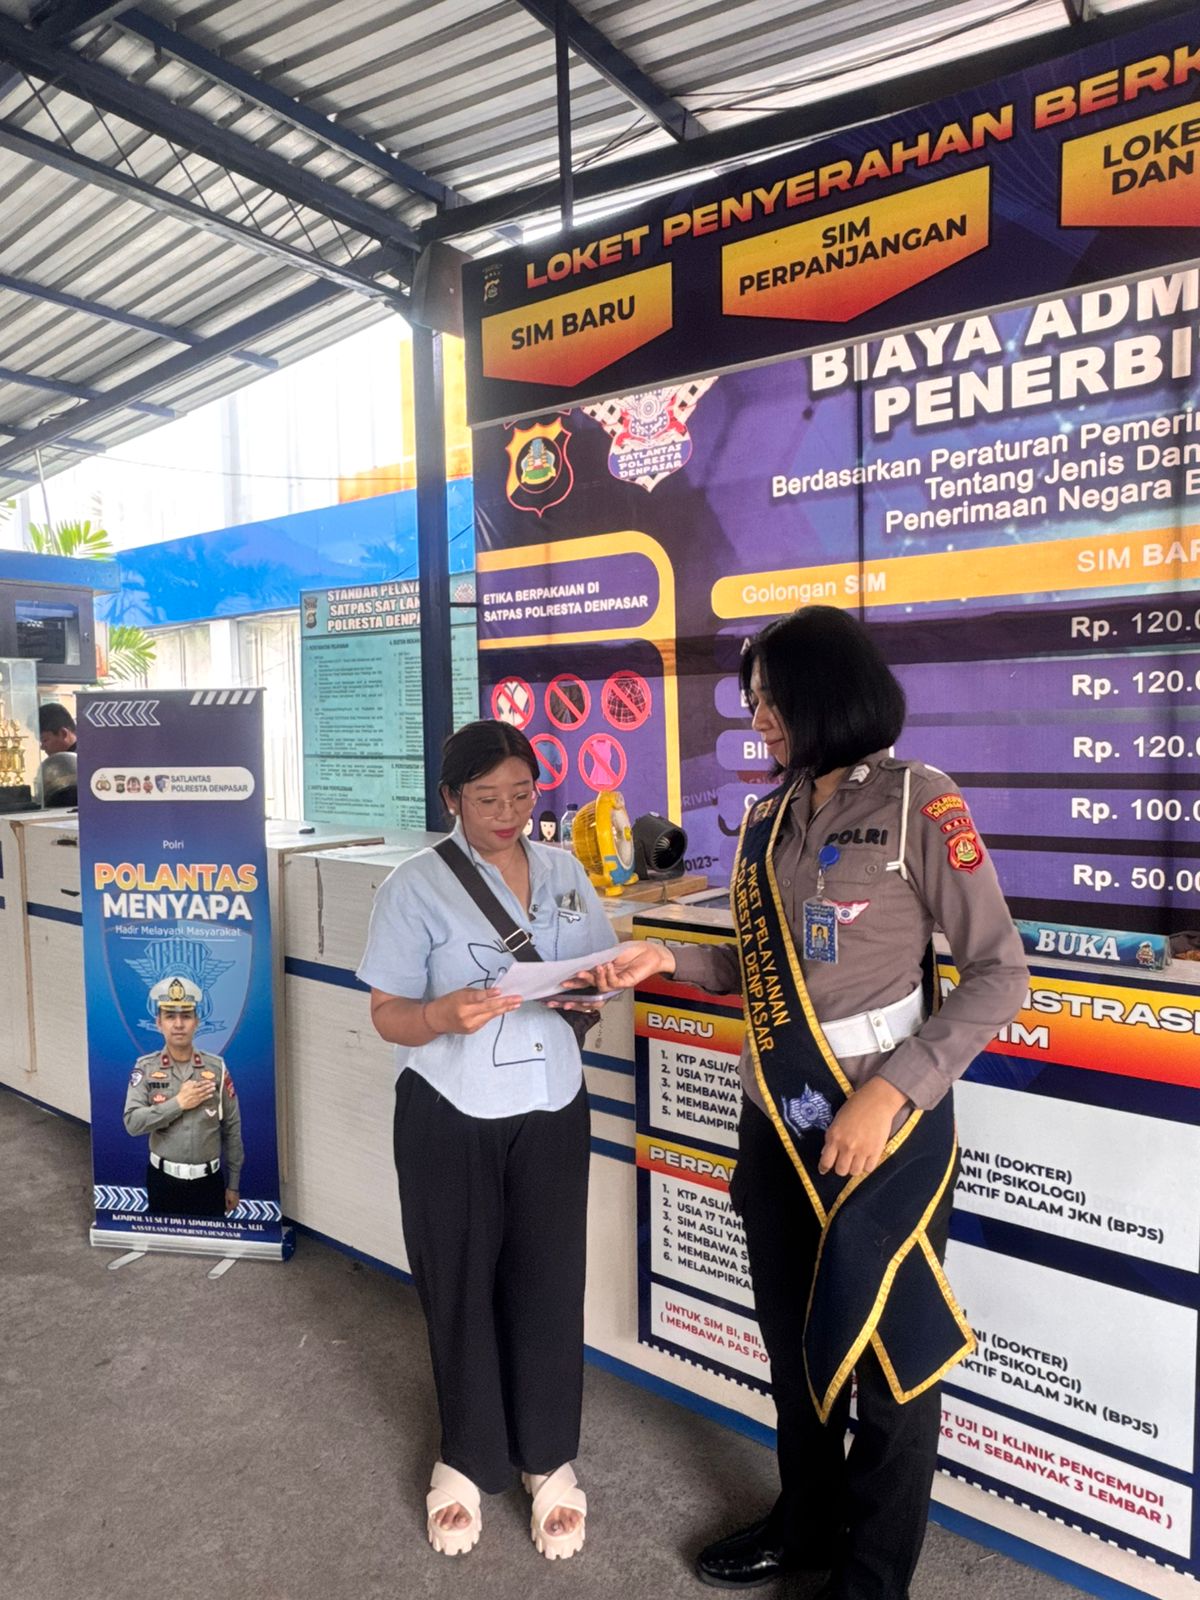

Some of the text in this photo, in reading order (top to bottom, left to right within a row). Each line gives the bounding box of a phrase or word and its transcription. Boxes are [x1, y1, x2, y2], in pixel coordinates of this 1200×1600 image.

[1103, 117, 1200, 169] LOKE
[1112, 150, 1195, 196] DAN
[526, 224, 650, 289] LOKET
[662, 104, 1014, 247] PENYERAHAN
[821, 216, 871, 249] SIM
[739, 214, 968, 296] PERPANJANGAN
[511, 295, 636, 350] SIM BARU
[811, 268, 1199, 392] BIAYA ADM
[874, 327, 1192, 434] PENERBI
[617, 443, 682, 463] SATLANTAS
[618, 452, 682, 471] POLRESTA
[771, 456, 922, 498] Berdasarkan
[931, 433, 1069, 473] Peraturan
[618, 460, 682, 478] DENPASAR
[925, 469, 1034, 501] Tentang
[1044, 452, 1125, 485] Jenis
[886, 494, 1047, 533] Penerimaan
[1058, 477, 1172, 512] Negara
[742, 580, 837, 604] Golongan
[1077, 547, 1130, 573] SIM
[327, 587, 378, 601] STANDAR
[483, 581, 600, 605] ETIKA BERPAKAIAN DI
[330, 603, 372, 617] SATPAS
[375, 599, 397, 612] SAT
[484, 595, 648, 623] SATPAS POLRESTA DENPASAR
[327, 615, 382, 632] POLRESTA
[1070, 616, 1118, 642] Rp.
[1071, 674, 1119, 700] Rp.
[1073, 736, 1120, 763] Rp.
[171, 775, 211, 783] SATLANTAS
[171, 784, 248, 793] POLRESTA DENPASAR
[1071, 798, 1118, 824] Rp.
[162, 839, 185, 850] Polri
[824, 828, 889, 847] POLRI
[94, 862, 258, 893] POLANTAS
[1073, 864, 1120, 891] Rp.
[103, 892, 253, 921] MENYAPA
[115, 925, 242, 938] Hadir Melayani Masyarakat
[747, 861, 791, 1027] PIKET PELAYANAN
[1035, 928, 1121, 962] BUKA
[737, 857, 775, 1052] POLRESTA DENPASAR
[647, 1011, 714, 1039] BARU
[661, 1050, 669, 1060] 1.
[676, 1053, 697, 1067] KTP
[661, 1065, 670, 1075] 2.
[676, 1067, 702, 1082] USIA
[704, 1072, 715, 1085] 17
[661, 1078, 671, 1089] 3.
[676, 1081, 738, 1104] MEMBAWA
[661, 1092, 672, 1102] 4.
[676, 1095, 738, 1118] MEMBAWA
[661, 1105, 672, 1116] 5.
[994, 1153, 1072, 1185] (DOKTER)
[662, 1184, 669, 1194] 1.
[677, 1187, 698, 1202] KTP
[987, 1169, 1086, 1206] (PSIKOLOGI)
[662, 1198, 672, 1208] 2.
[677, 1202, 703, 1218] USIA
[705, 1209, 716, 1222] 17
[955, 1180, 1164, 1244] AKTIF DALAM JKN (BPJS)
[663, 1211, 672, 1221] 3.
[677, 1216, 696, 1231] SIM
[699, 1222, 723, 1239] ASLI
[663, 1225, 673, 1236] 4.
[677, 1230, 738, 1258] MEMBAWA
[663, 1238, 672, 1248] 5.
[677, 1242, 738, 1271] MEMBAWA
[663, 1251, 673, 1262] 6.
[665, 1301, 762, 1349] UNTUK SIM BI, BII,
[666, 1316, 725, 1347] MEMBAWA
[728, 1339, 750, 1356] PAS
[991, 1333, 1069, 1372] (DOKTER)
[984, 1347, 1082, 1394] (PSIKOLOGI)
[1001, 1372, 1060, 1402] DALAM
[1063, 1394, 1097, 1416] JKN
[1102, 1406, 1159, 1439] (BPJS)
[955, 1414, 978, 1434] UJI
[982, 1425, 998, 1443] DI
[1002, 1433, 1056, 1464] KLINIK
[1060, 1455, 1165, 1507] PENGEMUDI
[957, 1431, 980, 1450] CM
[984, 1441, 1070, 1487] SEBANYAK
[1074, 1478, 1084, 1492] 3
[1088, 1484, 1162, 1525] LEMBAR
